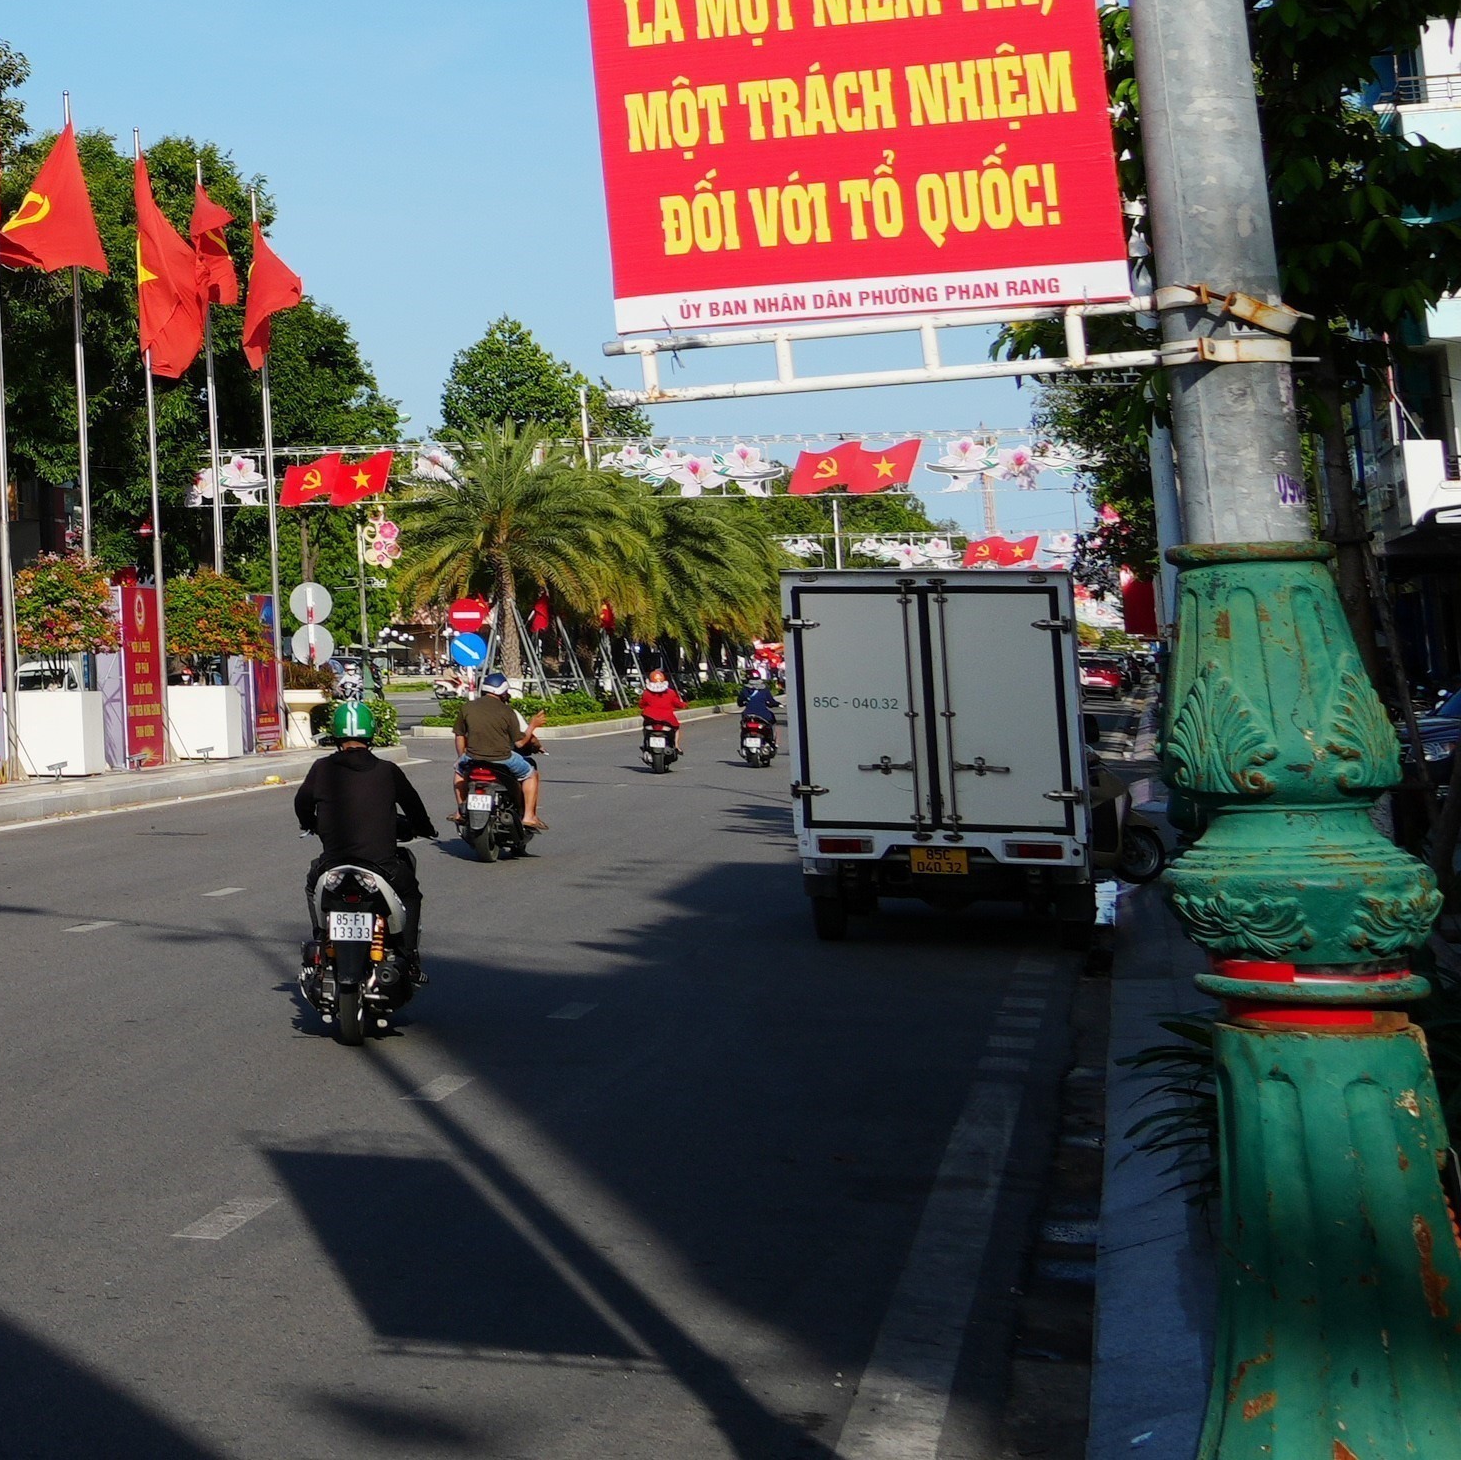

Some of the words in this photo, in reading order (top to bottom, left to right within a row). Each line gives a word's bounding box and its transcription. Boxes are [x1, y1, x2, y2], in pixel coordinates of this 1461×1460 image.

[624, 75, 727, 160] MỘT
[739, 61, 896, 142] TRÁCH
[904, 42, 1077, 130] NHIỆM
[659, 168, 740, 256] ĐỐI
[748, 170, 831, 248] VỚI
[839, 149, 903, 240] TỔ
[915, 143, 1062, 248] QUỐC!
[679, 297, 704, 320] ỦY
[709, 299, 747, 318] BAN
[753, 292, 806, 316] NHÂN
[813, 287, 852, 310] DÂN
[858, 284, 938, 307] PHƯỜNG
[945, 281, 998, 303] PHAN
[1006, 276, 1060, 298] RANG
[812, 696, 839, 709] 85C
[852, 696, 899, 710] 040.32
[925, 848, 951, 861] 85C
[917, 861, 963, 874] 040.32
[337, 914, 366, 926] 85-F1
[333, 927, 370, 939] 133.33
